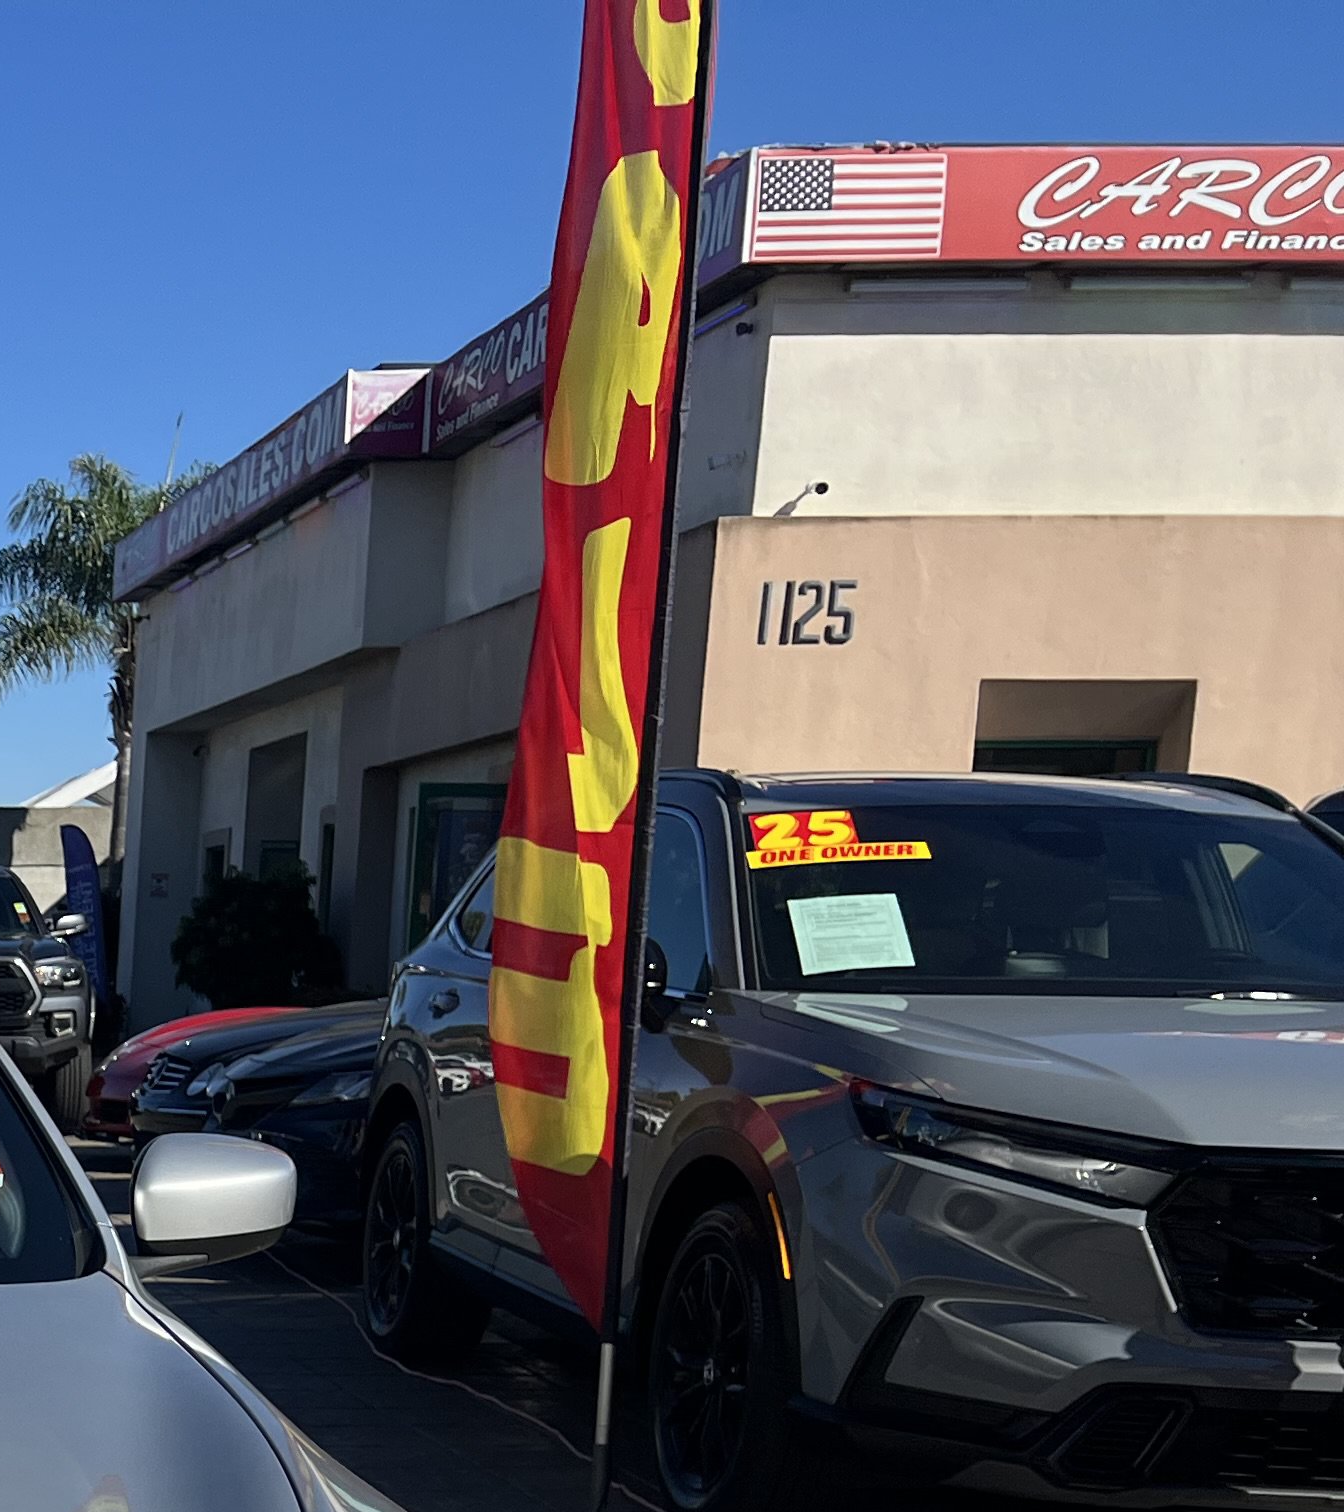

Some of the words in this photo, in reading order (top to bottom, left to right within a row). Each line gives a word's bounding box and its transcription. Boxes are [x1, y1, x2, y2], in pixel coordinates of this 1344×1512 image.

[1018, 231, 1126, 252] Sales
[1137, 230, 1213, 251] and
[1220, 230, 1344, 251] Financ
[437, 329, 506, 416] CARCO
[165, 387, 345, 555] CARCOSALES.COM
[757, 579, 859, 646] 1125
[753, 811, 854, 850] 25
[761, 850, 812, 864] ONE
[821, 843, 914, 859] OWNER
